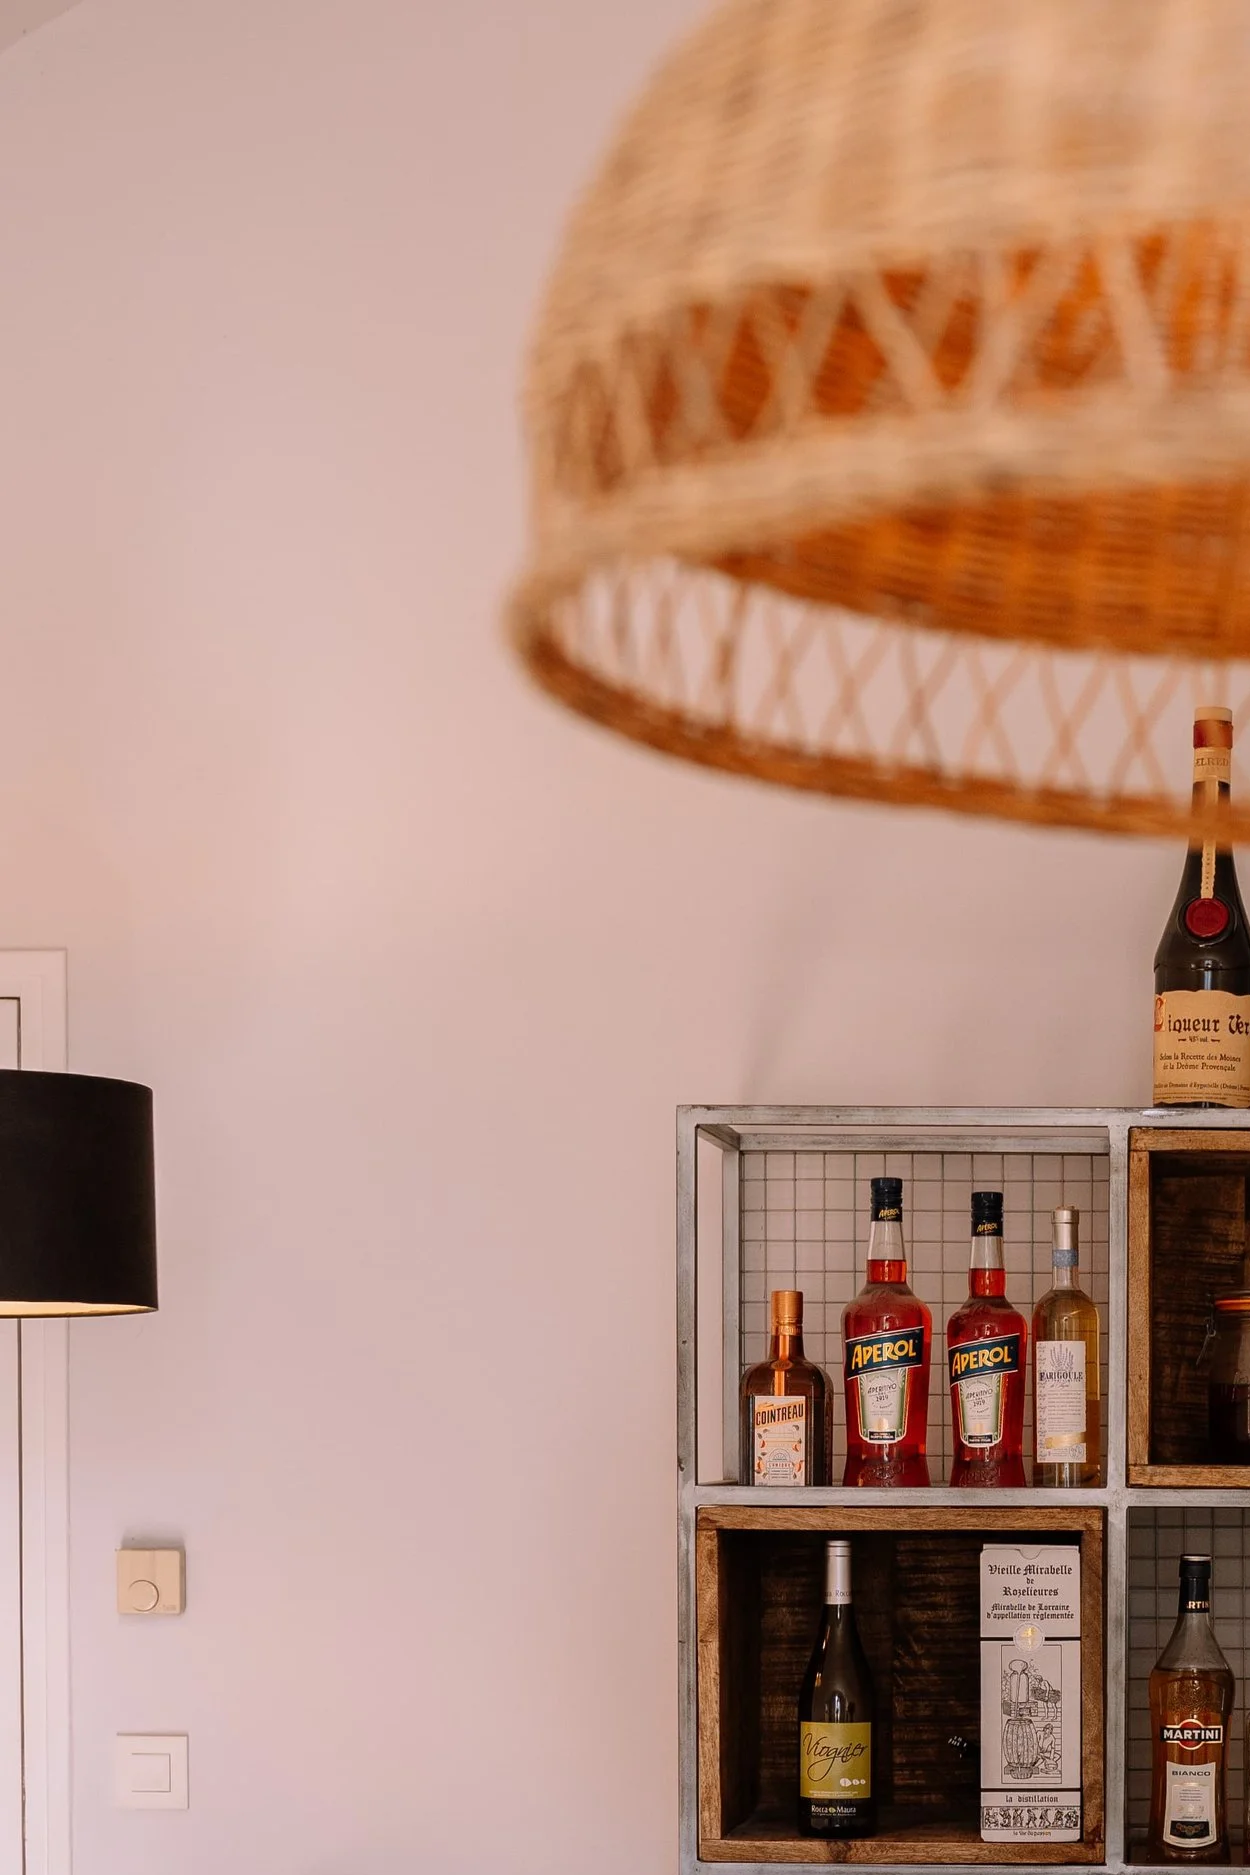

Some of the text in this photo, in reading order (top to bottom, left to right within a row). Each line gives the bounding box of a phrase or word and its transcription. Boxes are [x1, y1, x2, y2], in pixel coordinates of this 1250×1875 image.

[1195, 758, 1229, 767] ELRED
[851, 1339, 917, 1370] APEROL
[952, 1345, 1012, 1377] APEROL
[1040, 1372, 1083, 1381] FARIGOULE
[756, 1403, 804, 1426] COINTREAU
[988, 1564, 1073, 1576] Vieille Mirabelle
[1002, 1586, 1059, 1598] Rozelieures
[991, 1603, 1069, 1611] Mirabelle de Lorraine
[986, 1611, 1031, 1620] d'appellation
[1163, 1729, 1219, 1740] MARTINI
[803, 1733, 869, 1782] Viognier
[1018, 1794, 1059, 1803] distillation
[811, 1805, 828, 1813] Rocca
